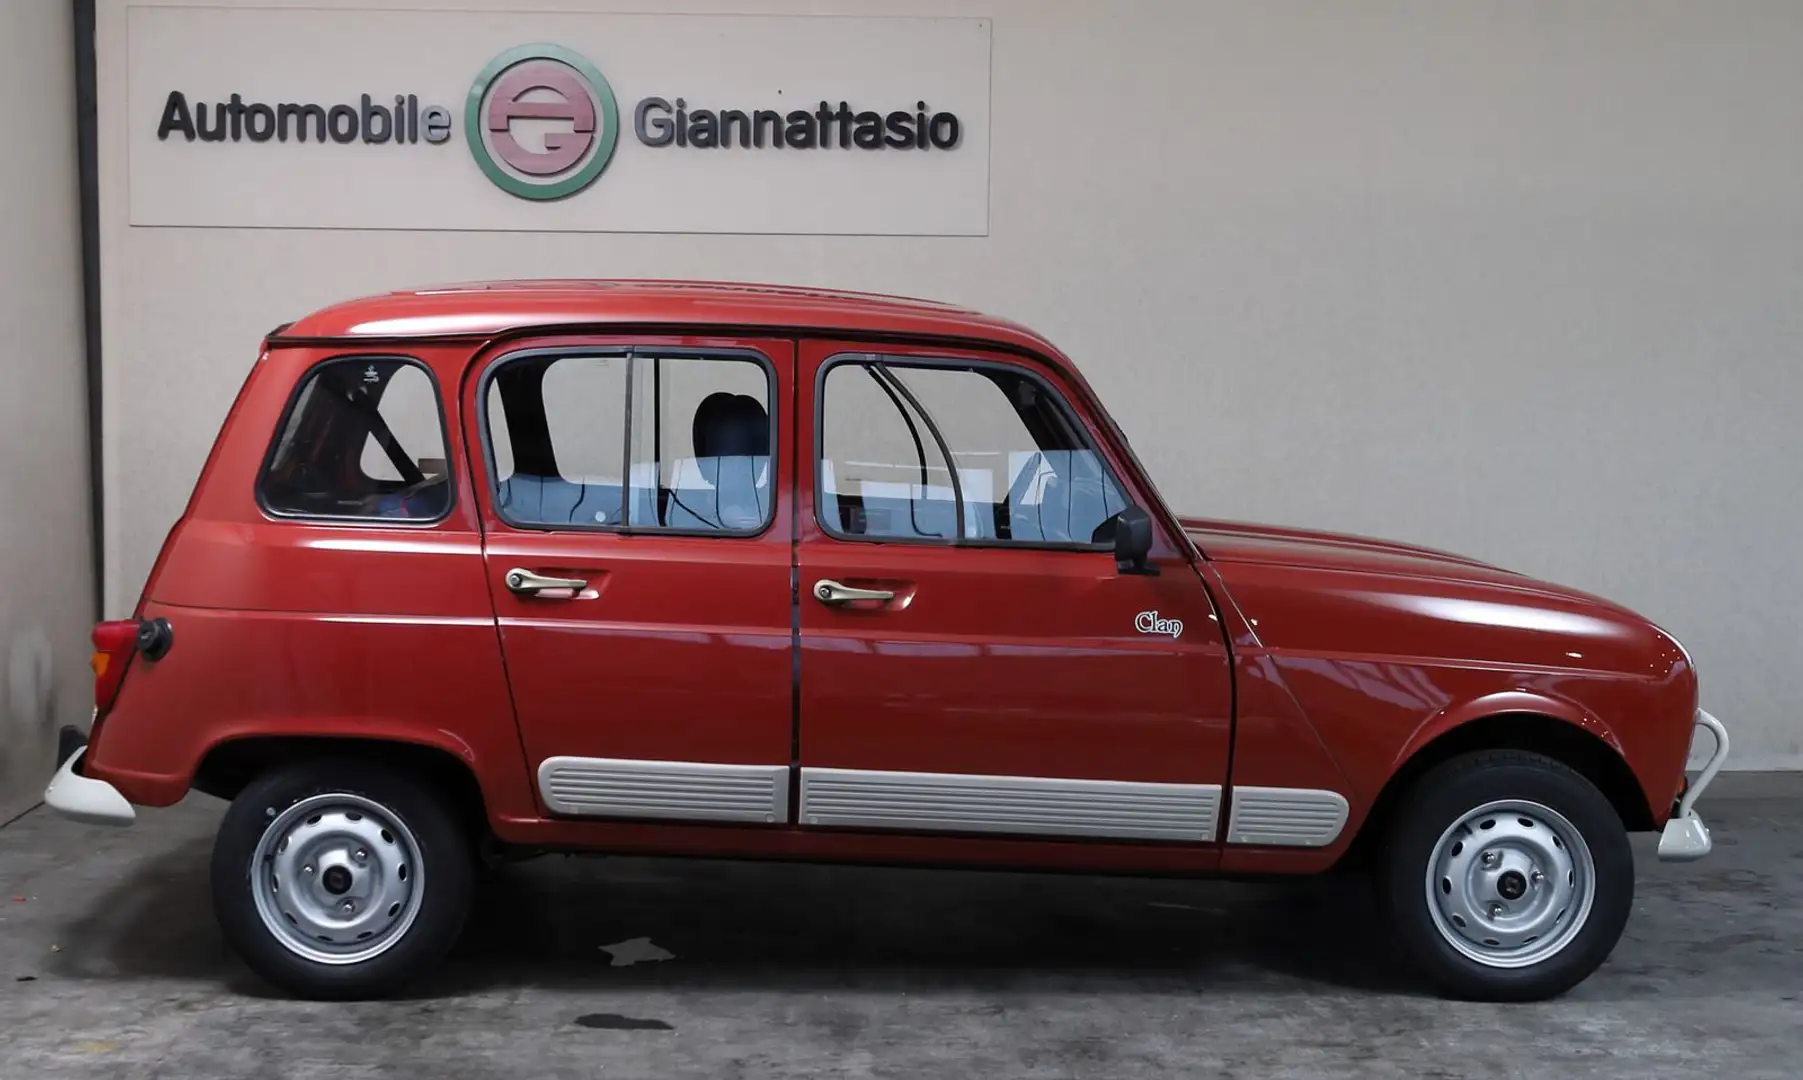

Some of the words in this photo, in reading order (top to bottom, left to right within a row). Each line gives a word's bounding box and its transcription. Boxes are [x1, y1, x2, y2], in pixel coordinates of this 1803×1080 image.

[157, 90, 452, 145] Automobile
[634, 97, 960, 149] Giannattasio
[1135, 610, 1183, 638] Clan
